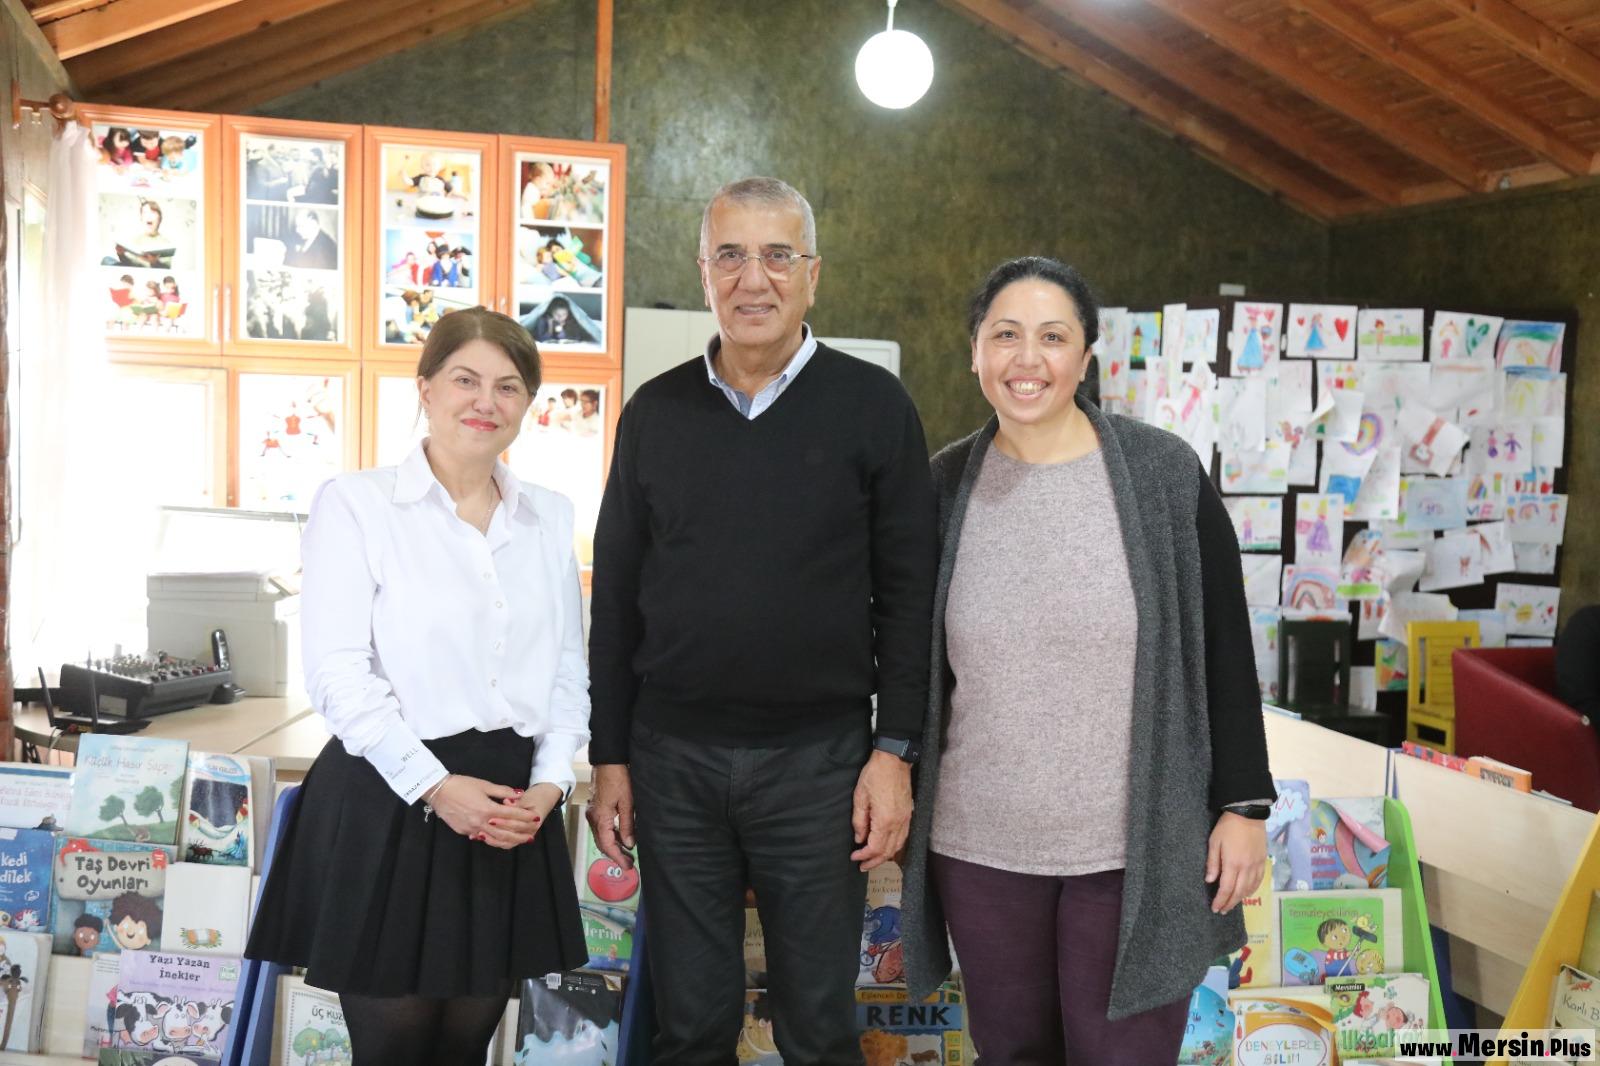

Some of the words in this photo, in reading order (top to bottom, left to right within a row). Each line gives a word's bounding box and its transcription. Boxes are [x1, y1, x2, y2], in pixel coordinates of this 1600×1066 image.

[1, 851, 28, 867] kedi
[75, 856, 103, 874] Taş
[108, 856, 150, 873] Devri
[77, 875, 148, 896] Oyunları
[149, 954, 173, 965] Yazı
[176, 956, 210, 969] Yazan
[159, 967, 201, 982] İnekler
[1562, 993, 1587, 1016] Karlı
[326, 1008, 344, 1022] KUZ
[866, 1005, 951, 1026] RENK
